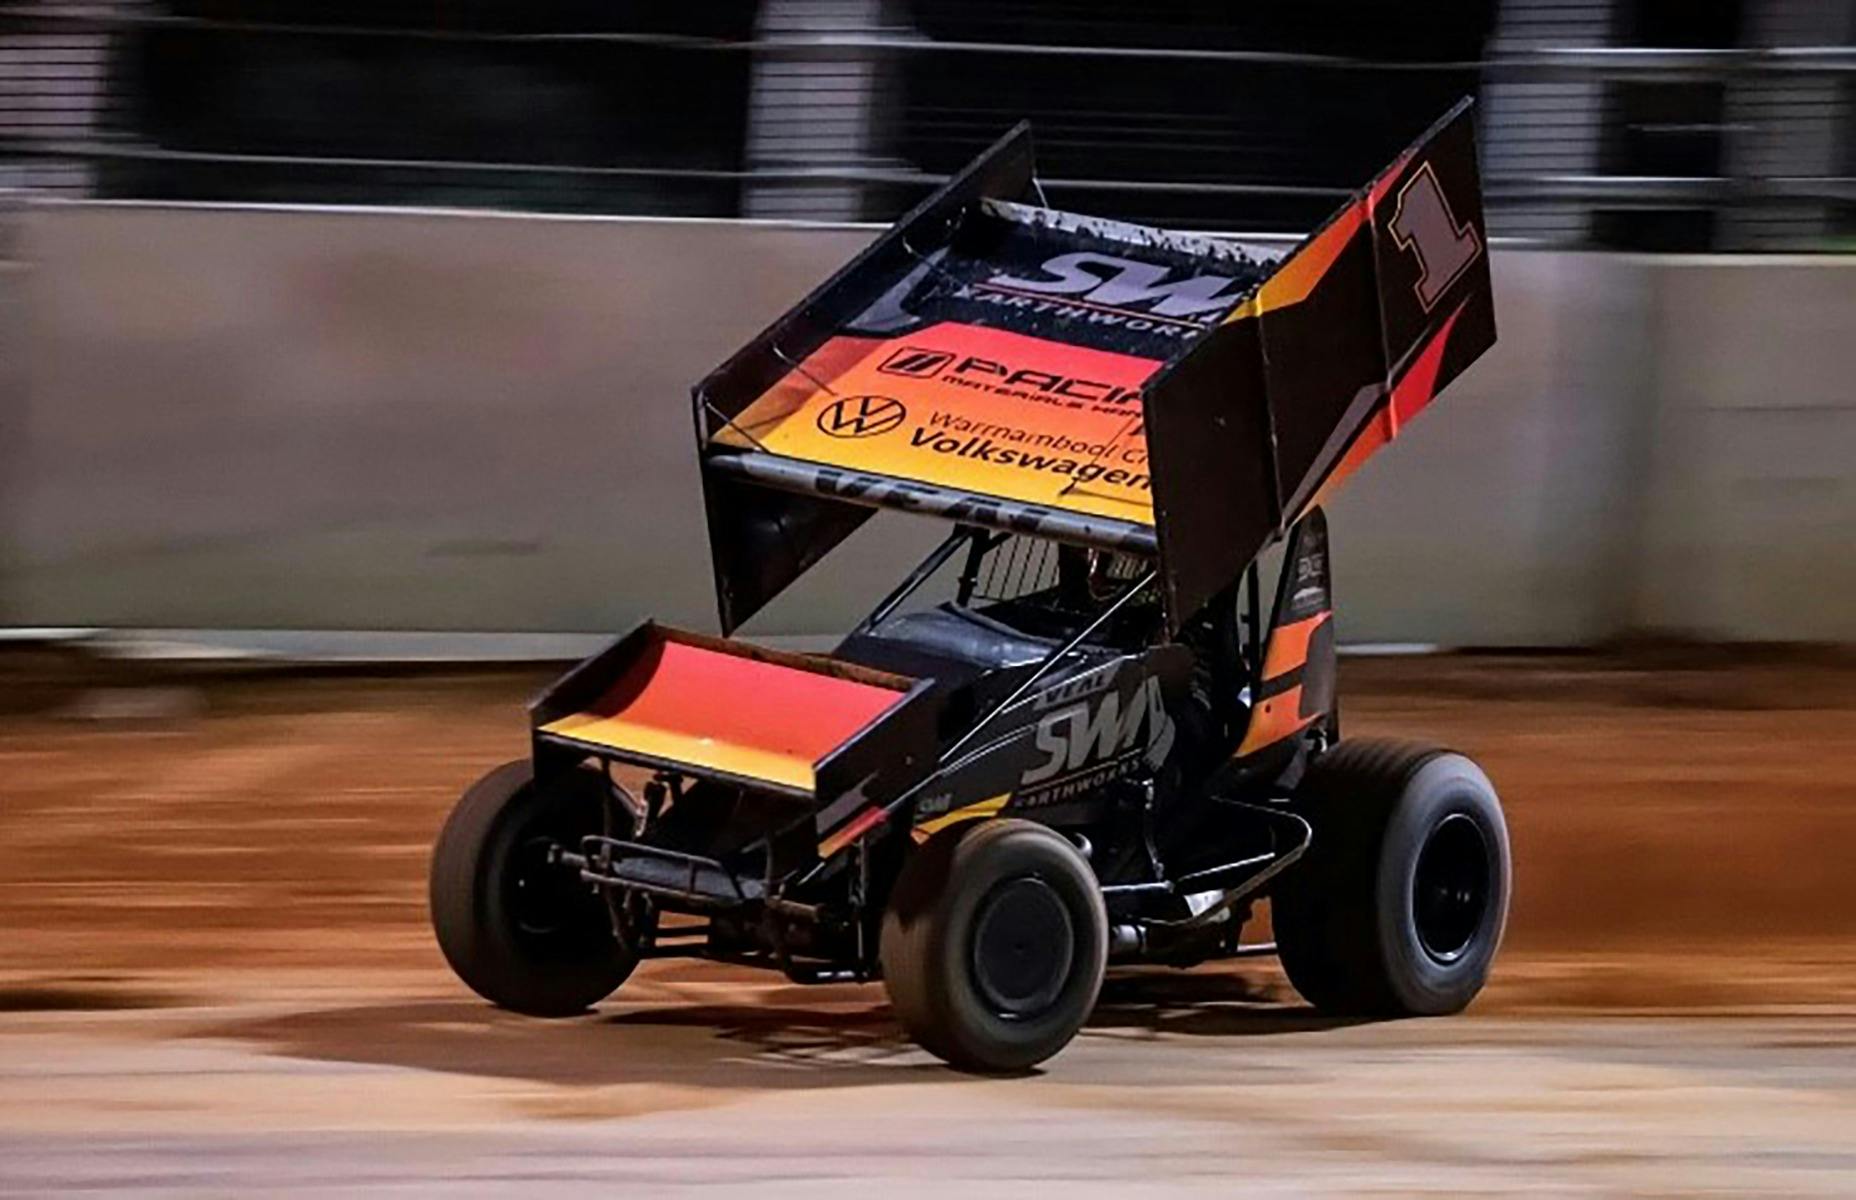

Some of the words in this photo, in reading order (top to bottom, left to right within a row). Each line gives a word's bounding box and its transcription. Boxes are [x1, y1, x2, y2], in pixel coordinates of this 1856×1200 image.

[1388, 160, 1482, 314] 1
[910, 427, 1151, 490] Volkswagen
[929, 411, 1119, 458] Warrnambool
